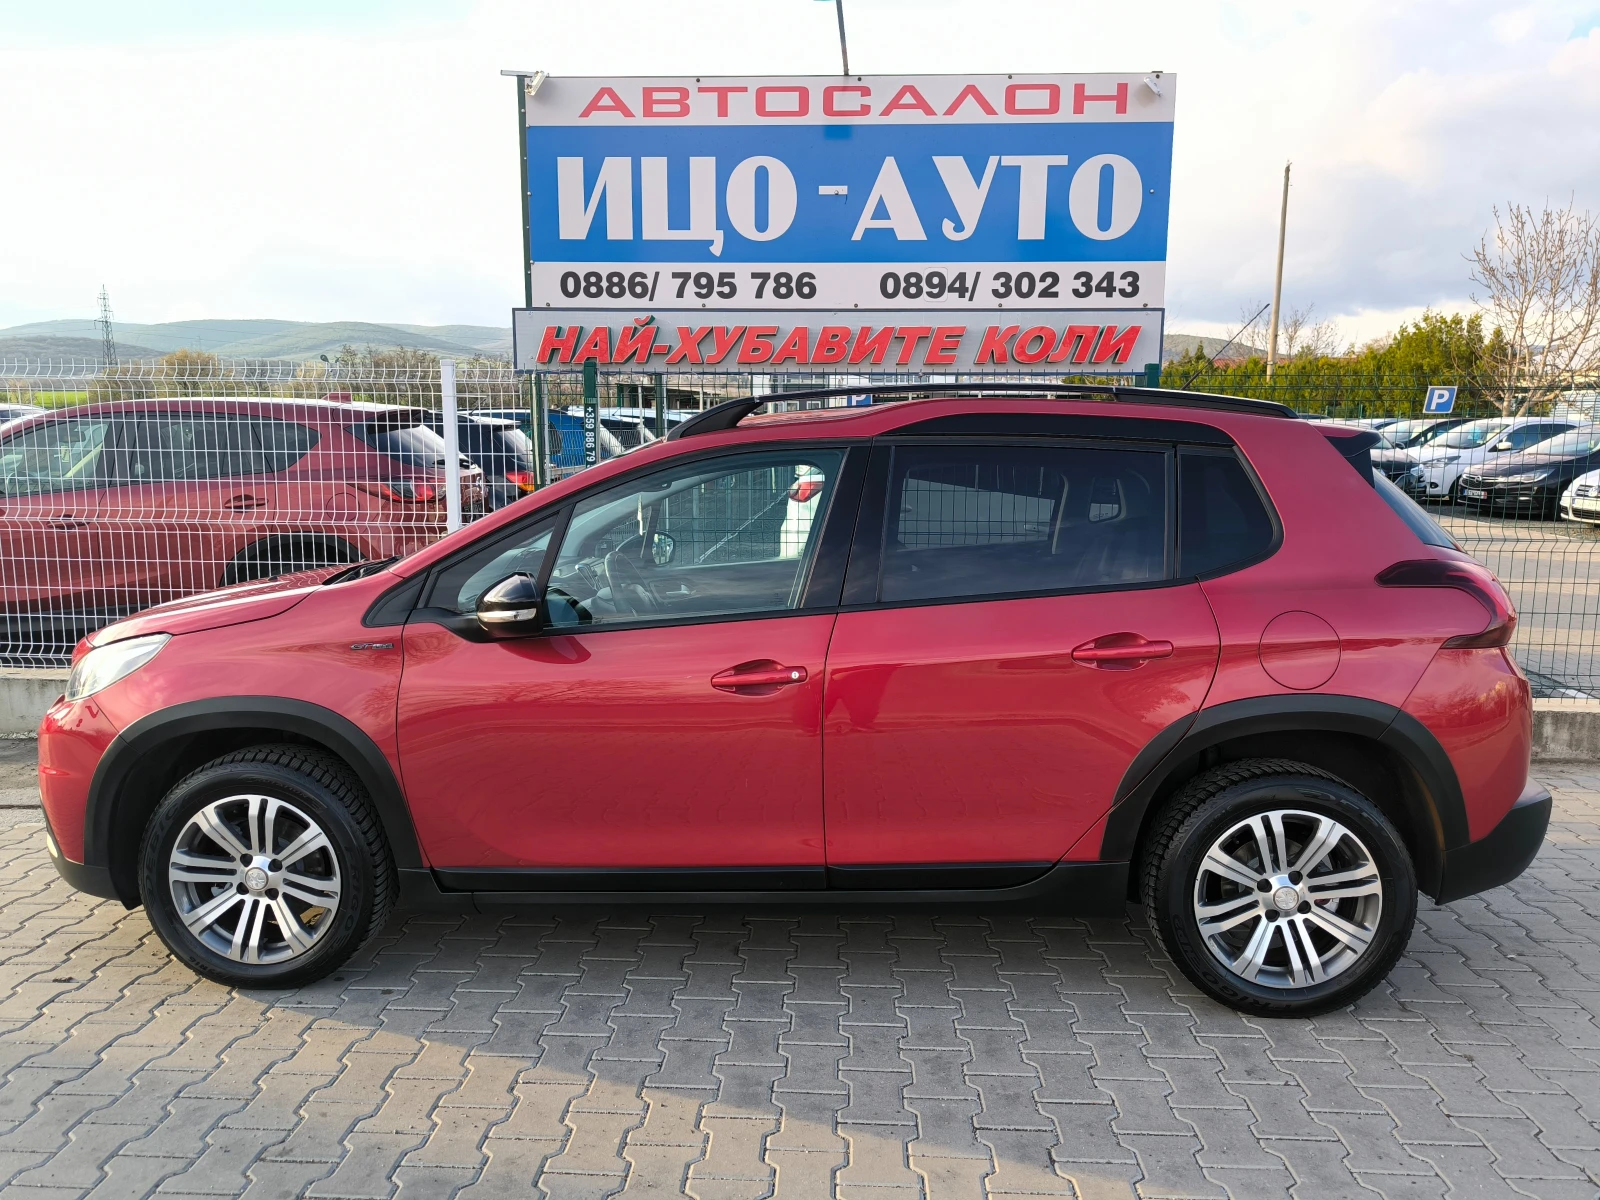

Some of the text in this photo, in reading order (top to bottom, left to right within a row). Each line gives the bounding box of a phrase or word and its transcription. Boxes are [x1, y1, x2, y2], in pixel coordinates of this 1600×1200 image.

[578, 83, 1129, 118] АВТОСАЛОН
[560, 271, 817, 301] 0886/ 795 786
[879, 271, 1141, 301] 0894/ 302 343
[535, 315, 1143, 364] НАЙ-ХУБАВИТЕ КОЛИ
[1430, 389, 1450, 410] P
[585, 407, 595, 429] +359
[585, 432, 595, 448] 886
[586, 451, 595, 462] 79
